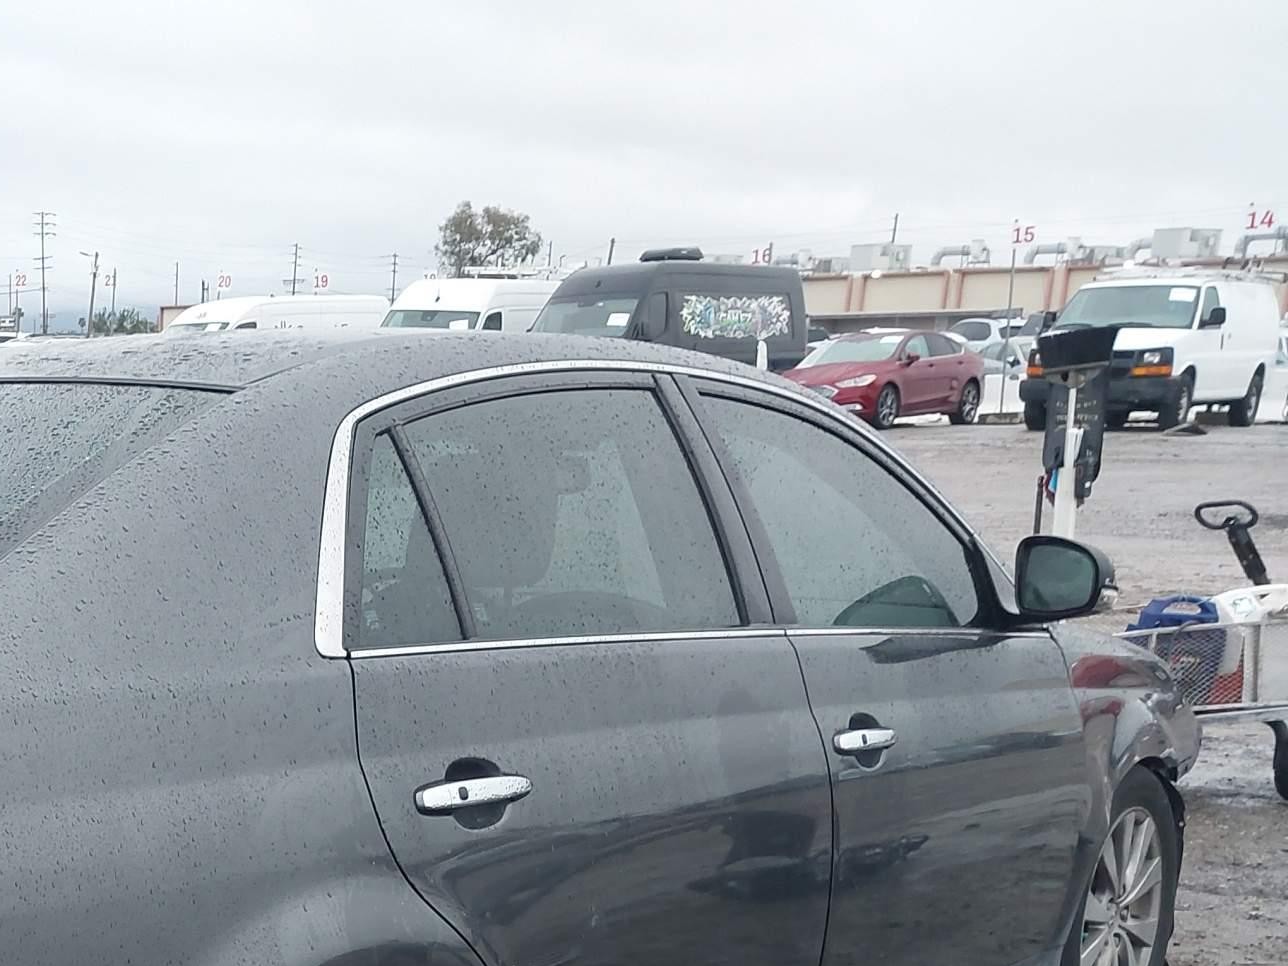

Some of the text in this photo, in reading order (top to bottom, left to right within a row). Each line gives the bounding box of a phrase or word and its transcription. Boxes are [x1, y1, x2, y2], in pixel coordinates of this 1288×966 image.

[1245, 209, 1275, 229] 14
[1012, 225, 1035, 243] 15
[752, 247, 772, 264] 16
[15, 274, 27, 287] 22
[218, 275, 231, 288] 20
[314, 275, 328, 288] 19
